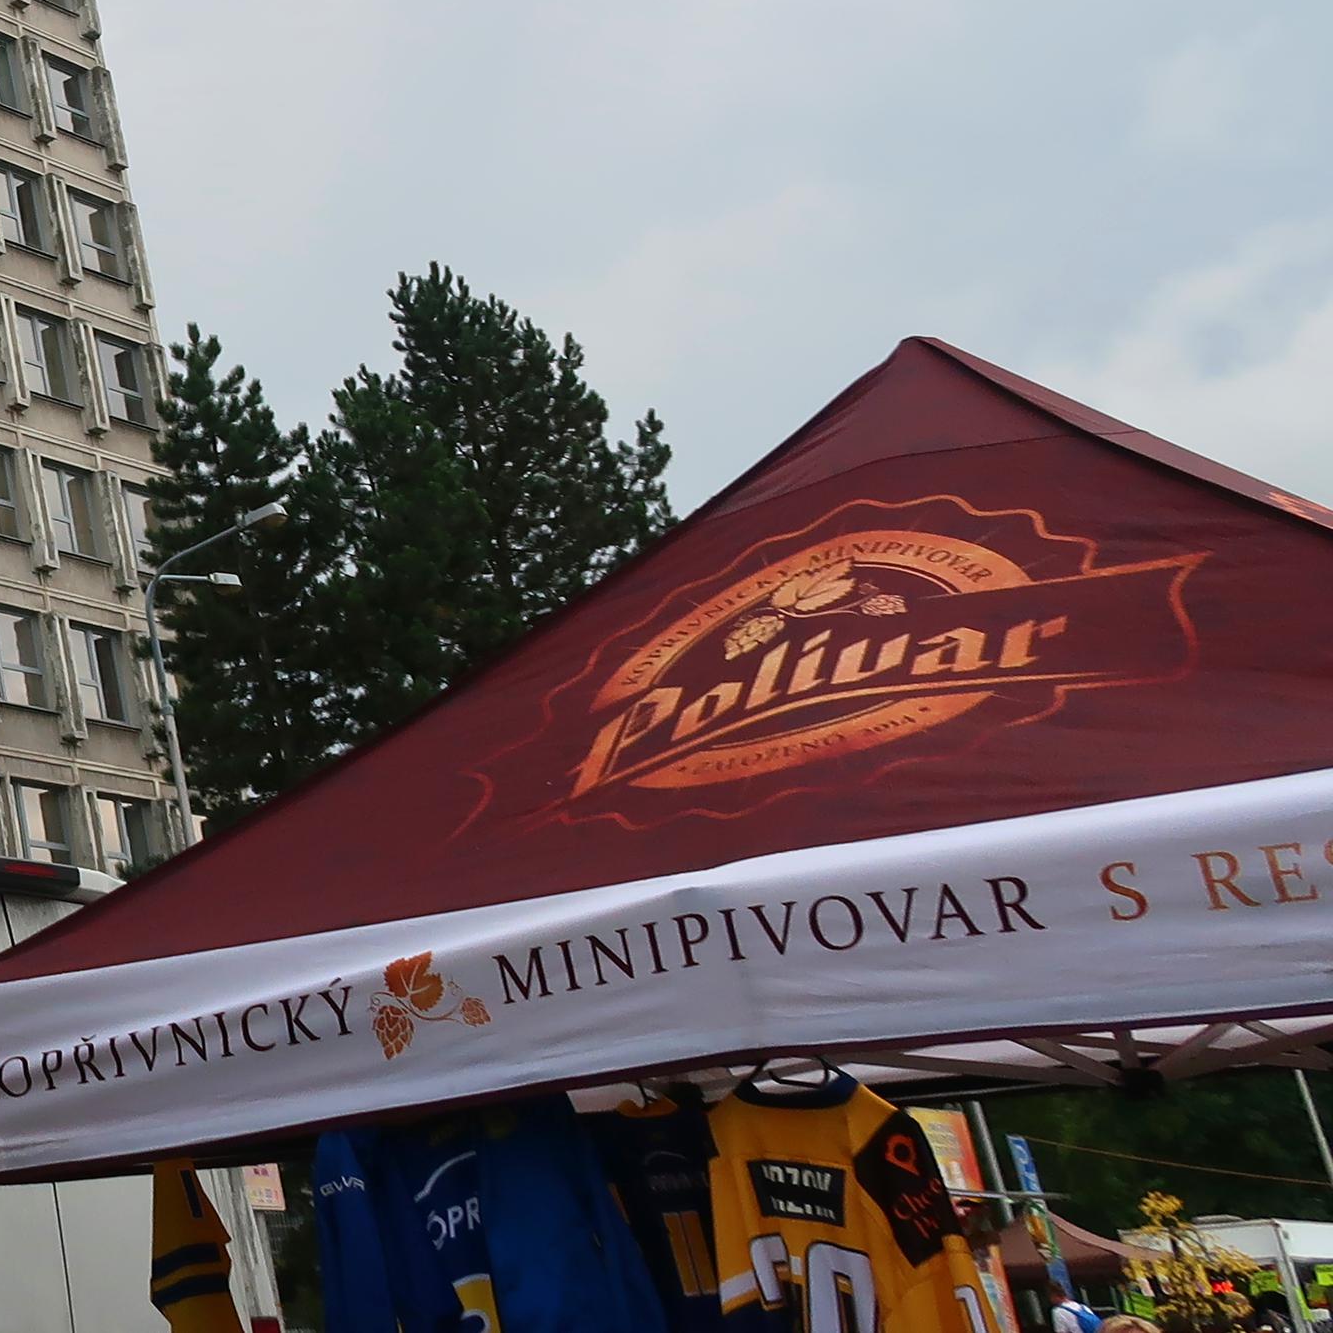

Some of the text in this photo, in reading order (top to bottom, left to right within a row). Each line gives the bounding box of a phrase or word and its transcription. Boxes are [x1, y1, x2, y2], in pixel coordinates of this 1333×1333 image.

[493, 875, 1048, 1004] MINIPIVOVAR
[1098, 861, 1149, 923] S
[1190, 838, 1333, 911] RE
